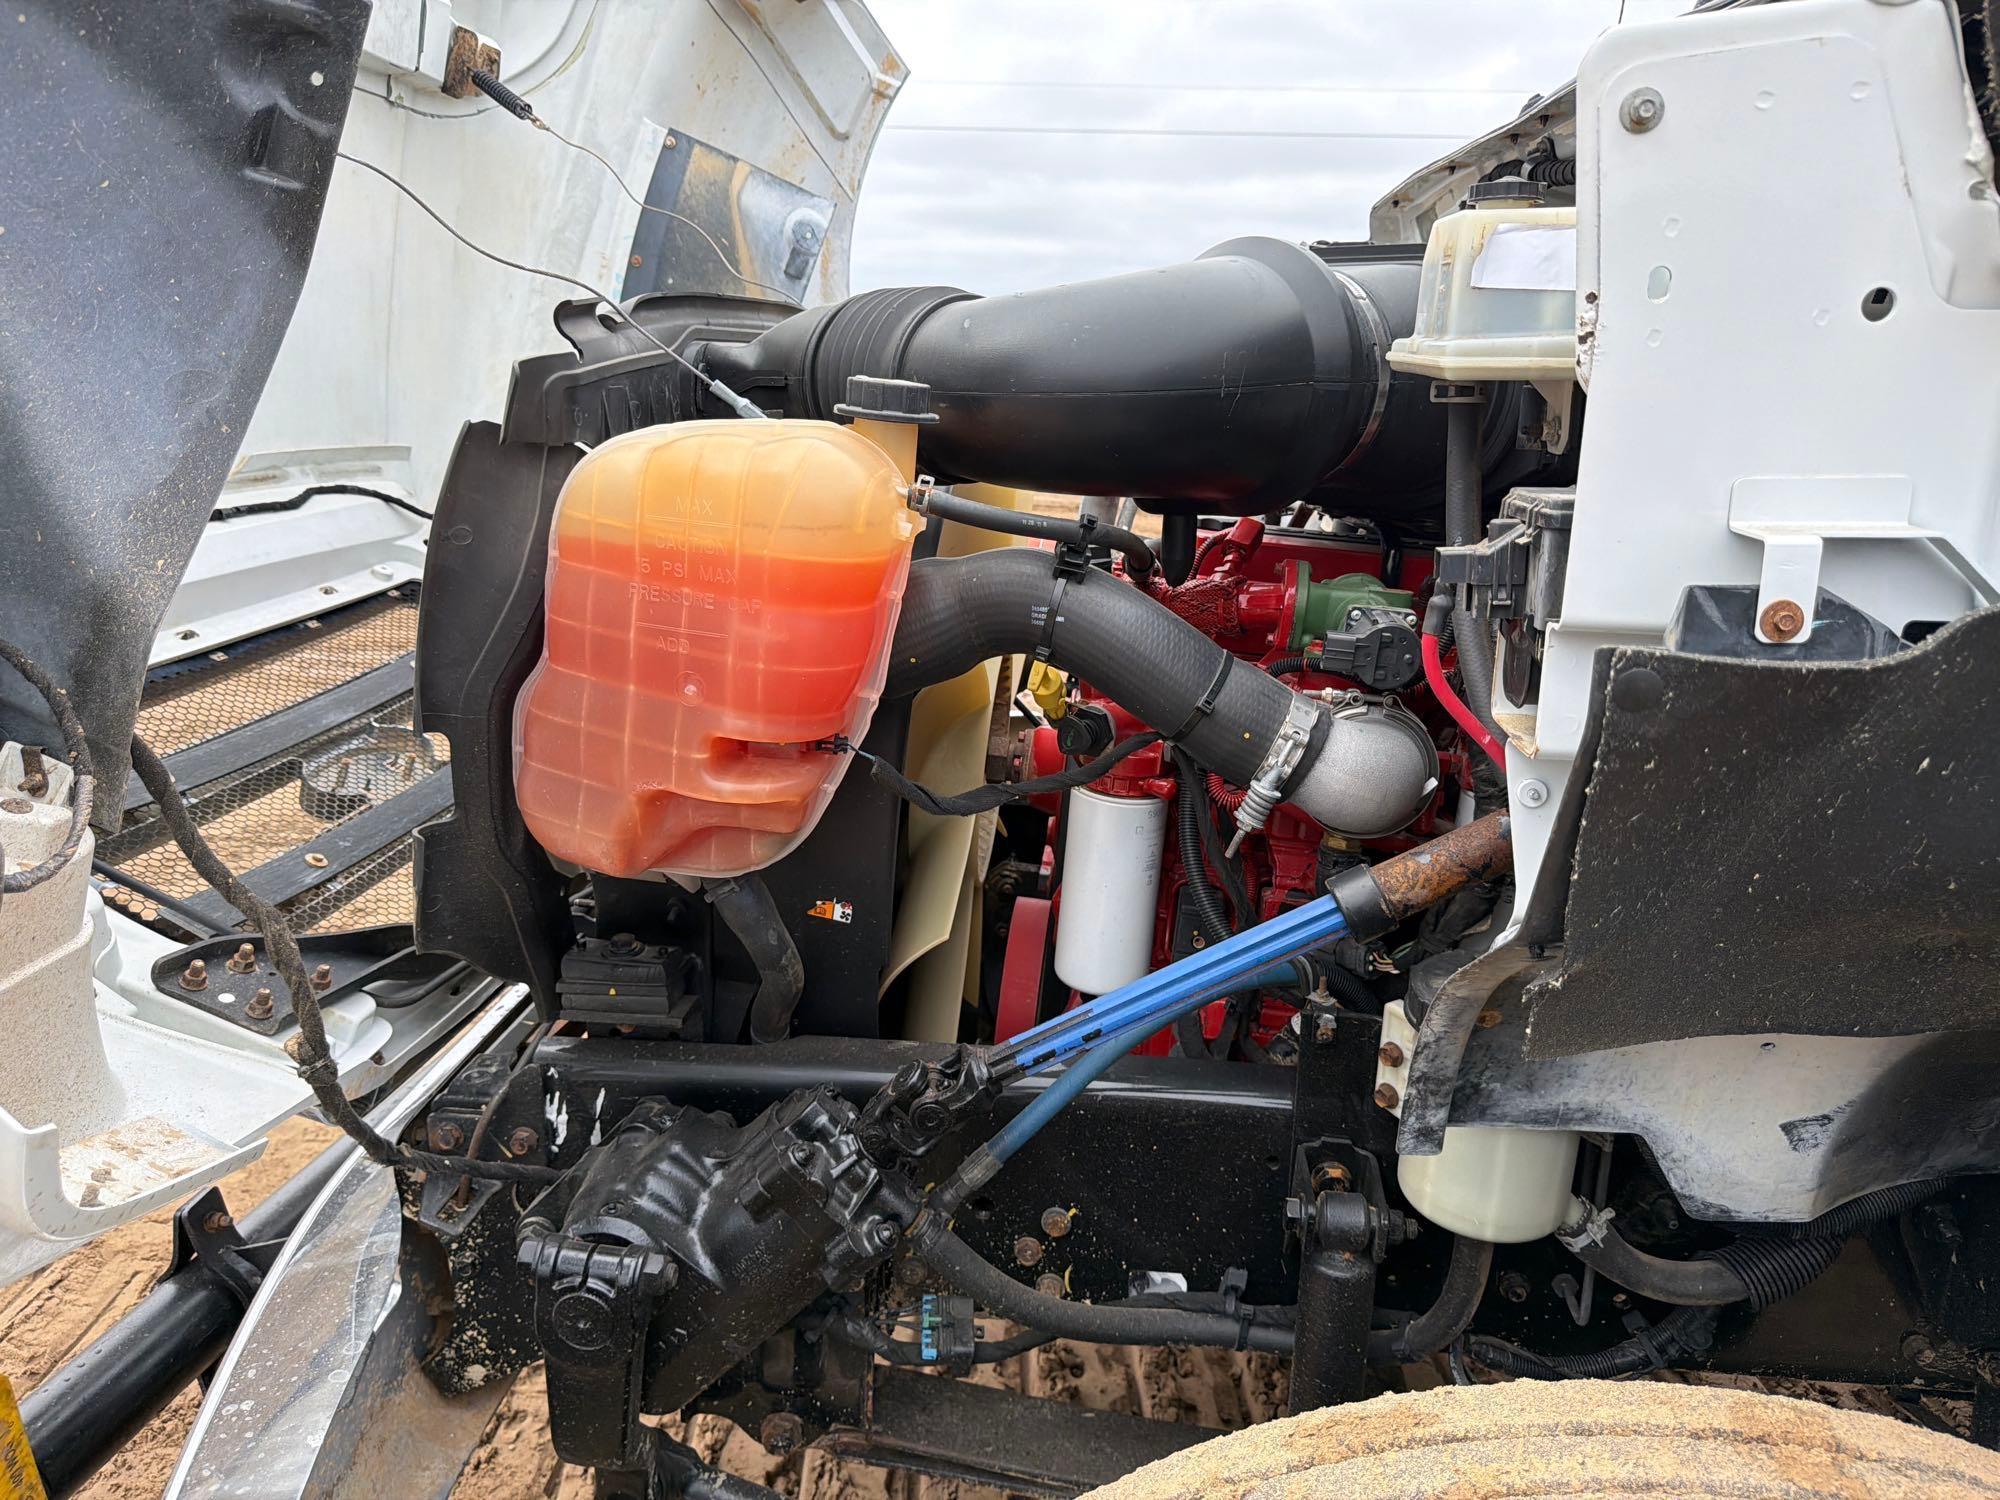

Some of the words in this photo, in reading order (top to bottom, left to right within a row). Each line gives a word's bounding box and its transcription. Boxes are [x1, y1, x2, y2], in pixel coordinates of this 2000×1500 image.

[675, 496, 713, 515] MAX
[656, 534, 728, 556] CAUTION
[662, 561, 688, 579] PSI
[700, 565, 737, 585] MAX
[628, 582, 715, 610] PRESSURE
[728, 596, 762, 614] CAP
[656, 635, 690, 654] ADD
